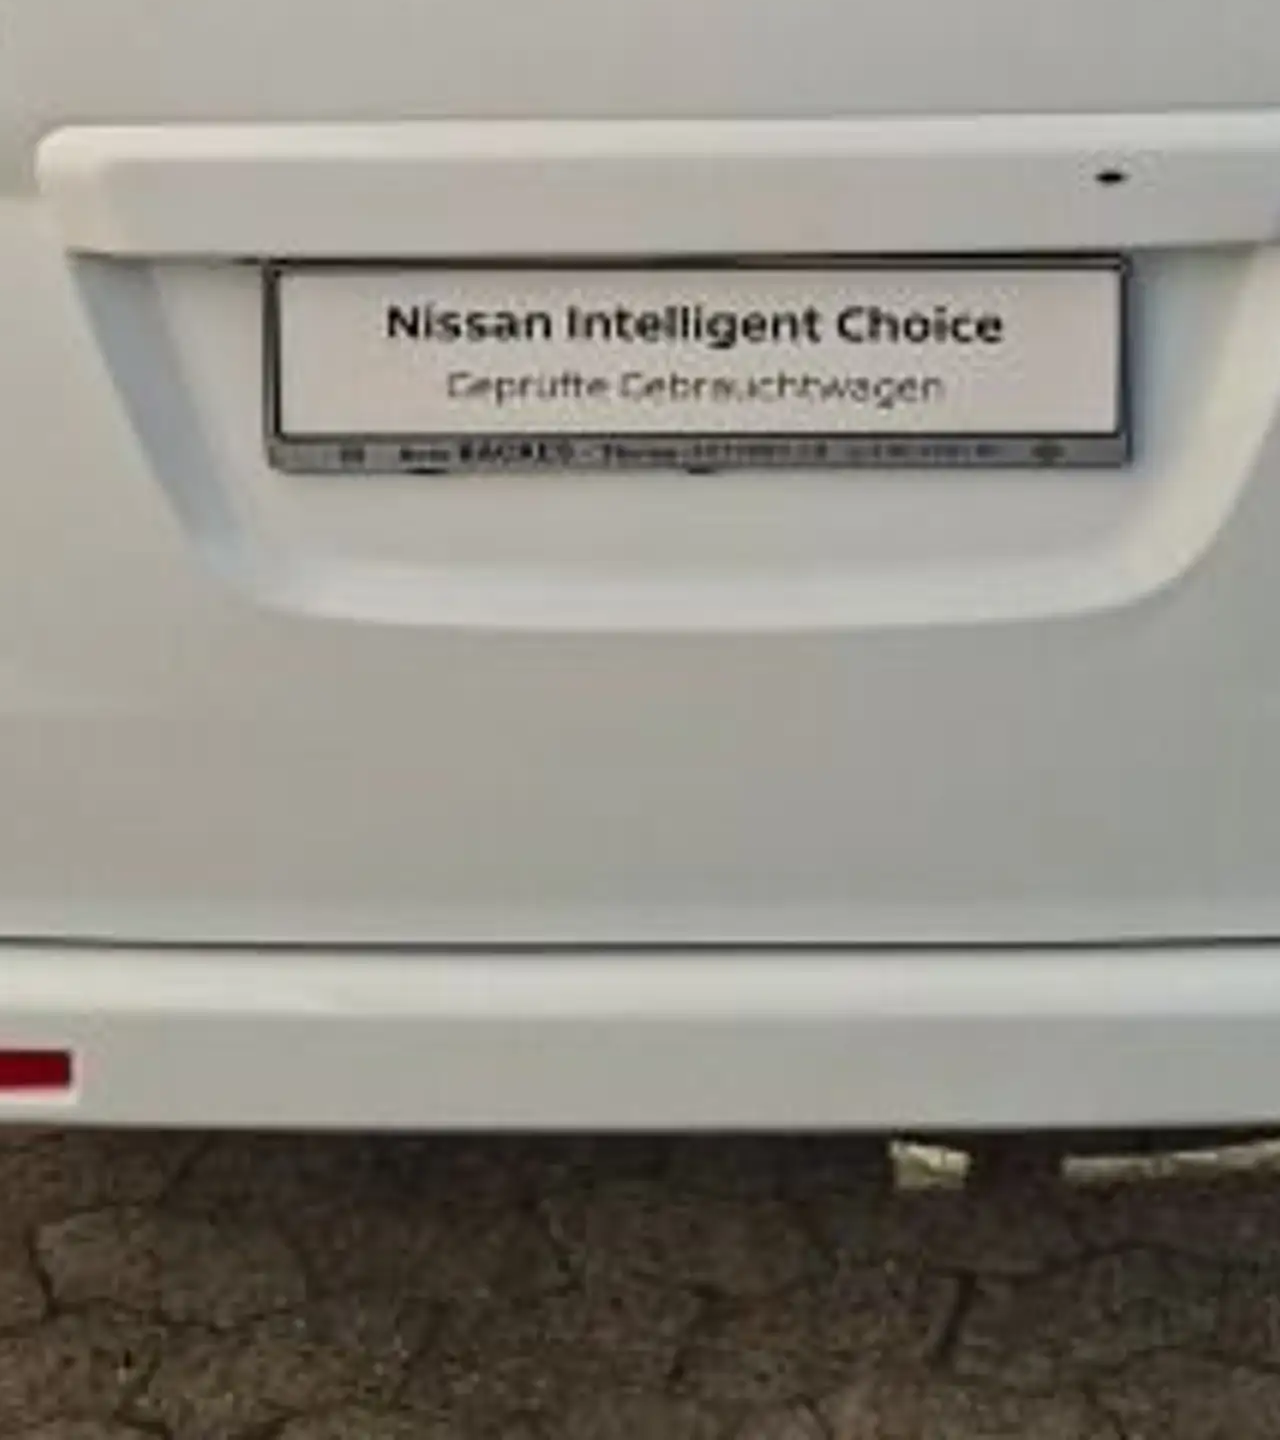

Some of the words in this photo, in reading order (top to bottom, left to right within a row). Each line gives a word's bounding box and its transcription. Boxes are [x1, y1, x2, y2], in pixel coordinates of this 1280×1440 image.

[386, 304, 552, 340] Nissan
[567, 304, 821, 349] Intelligent
[835, 304, 1004, 344] Choice
[621, 371, 943, 410] Gebrauchtwagen
